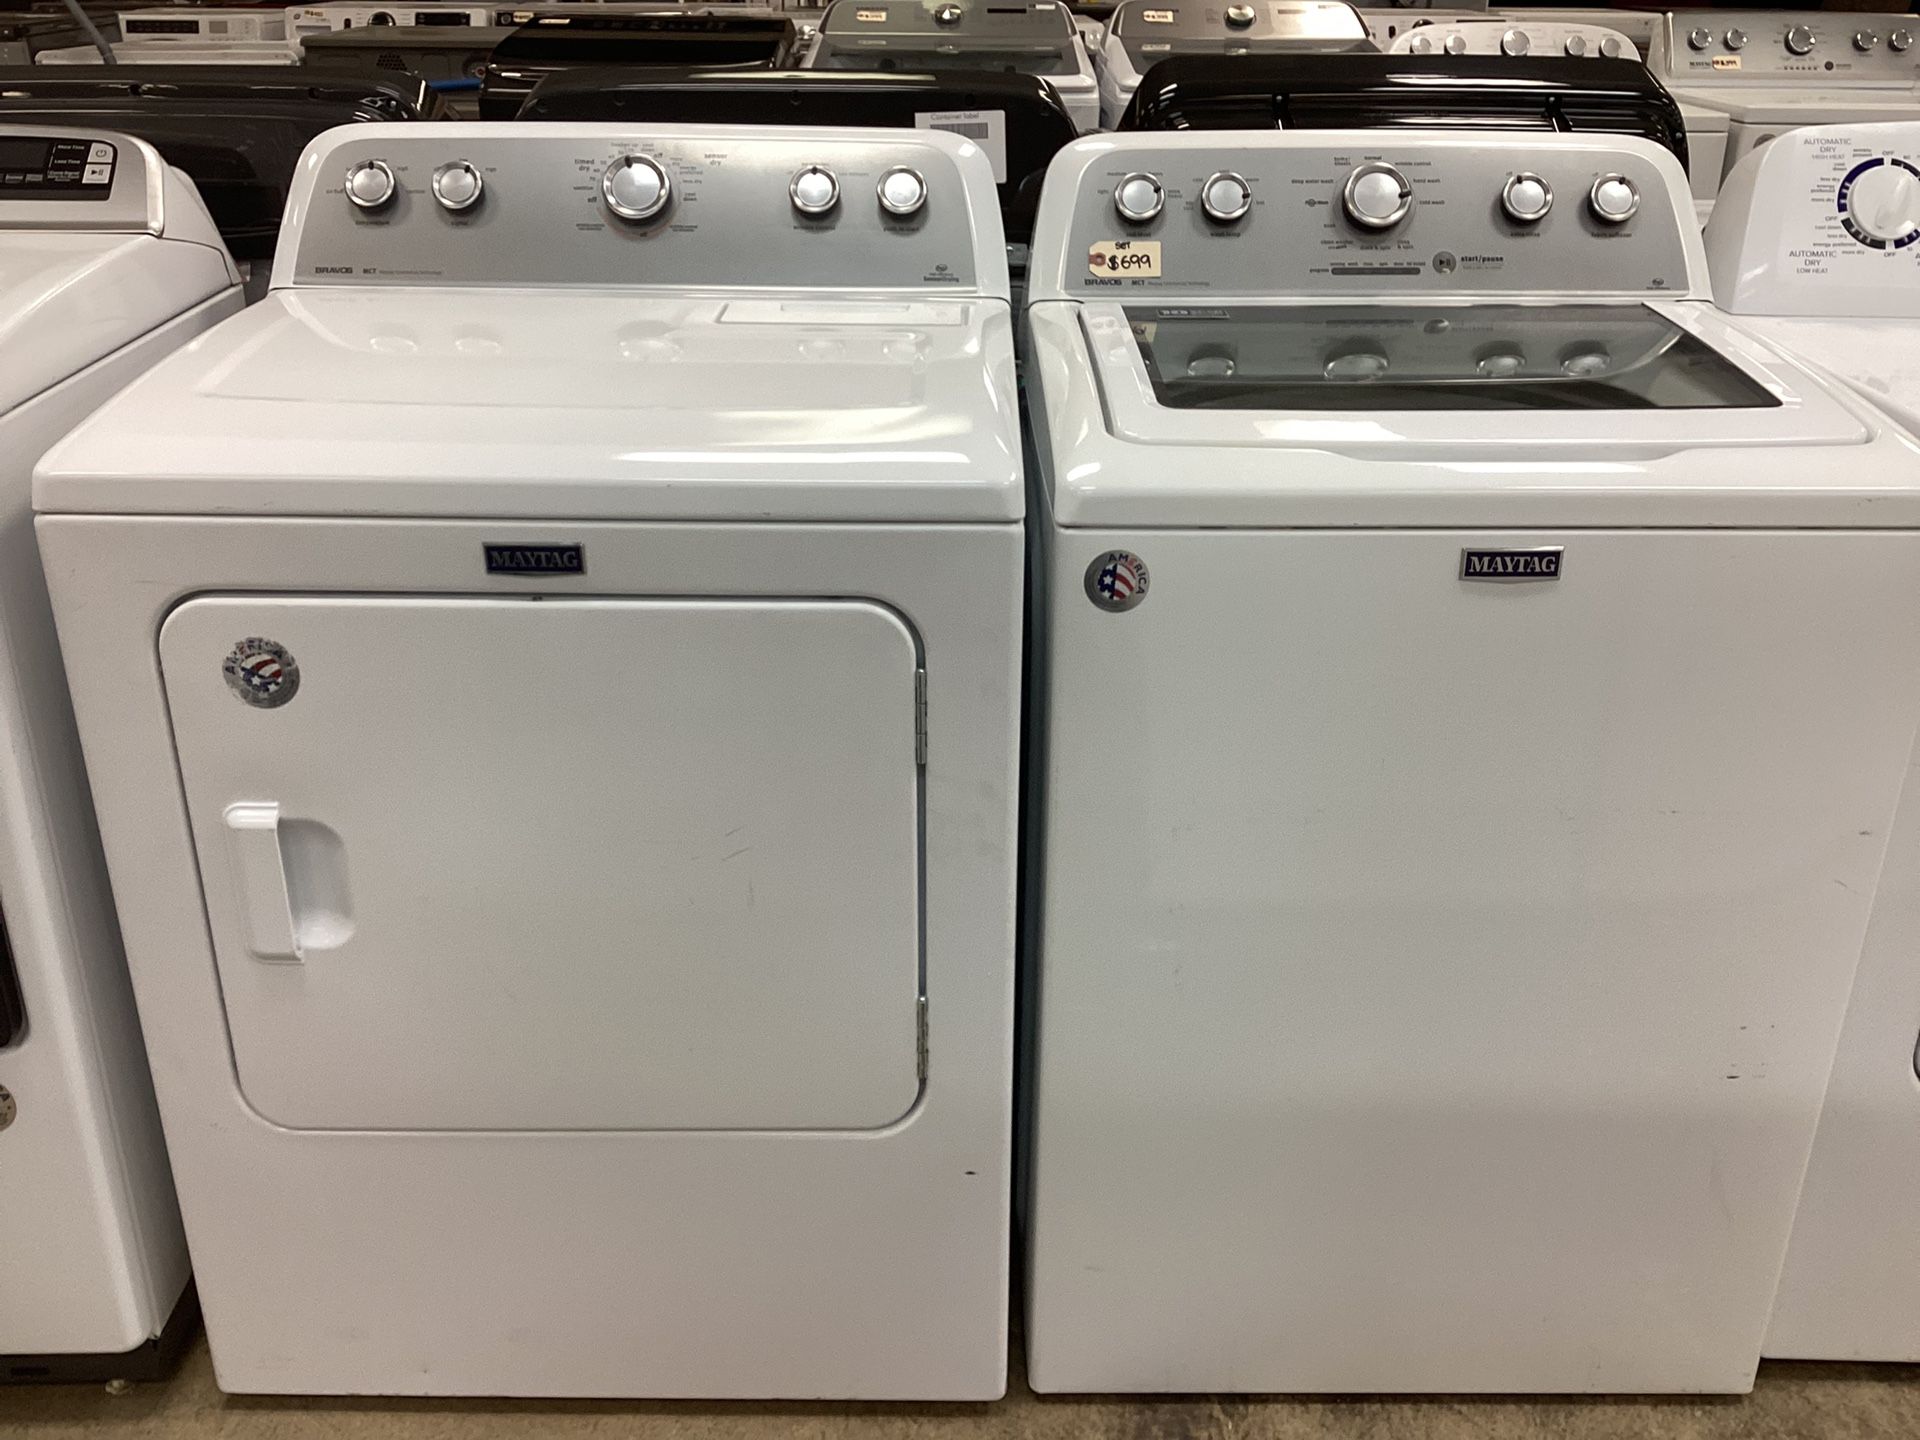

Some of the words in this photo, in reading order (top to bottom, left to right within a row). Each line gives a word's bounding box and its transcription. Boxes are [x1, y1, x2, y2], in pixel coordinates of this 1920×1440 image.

[1107, 254, 1152, 271] $699
[1461, 254, 1504, 264] start/pause
[314, 266, 353, 274] BRAVOS
[489, 551, 578, 568] MAYTAG
[1468, 556, 1556, 573] MAYTAG
